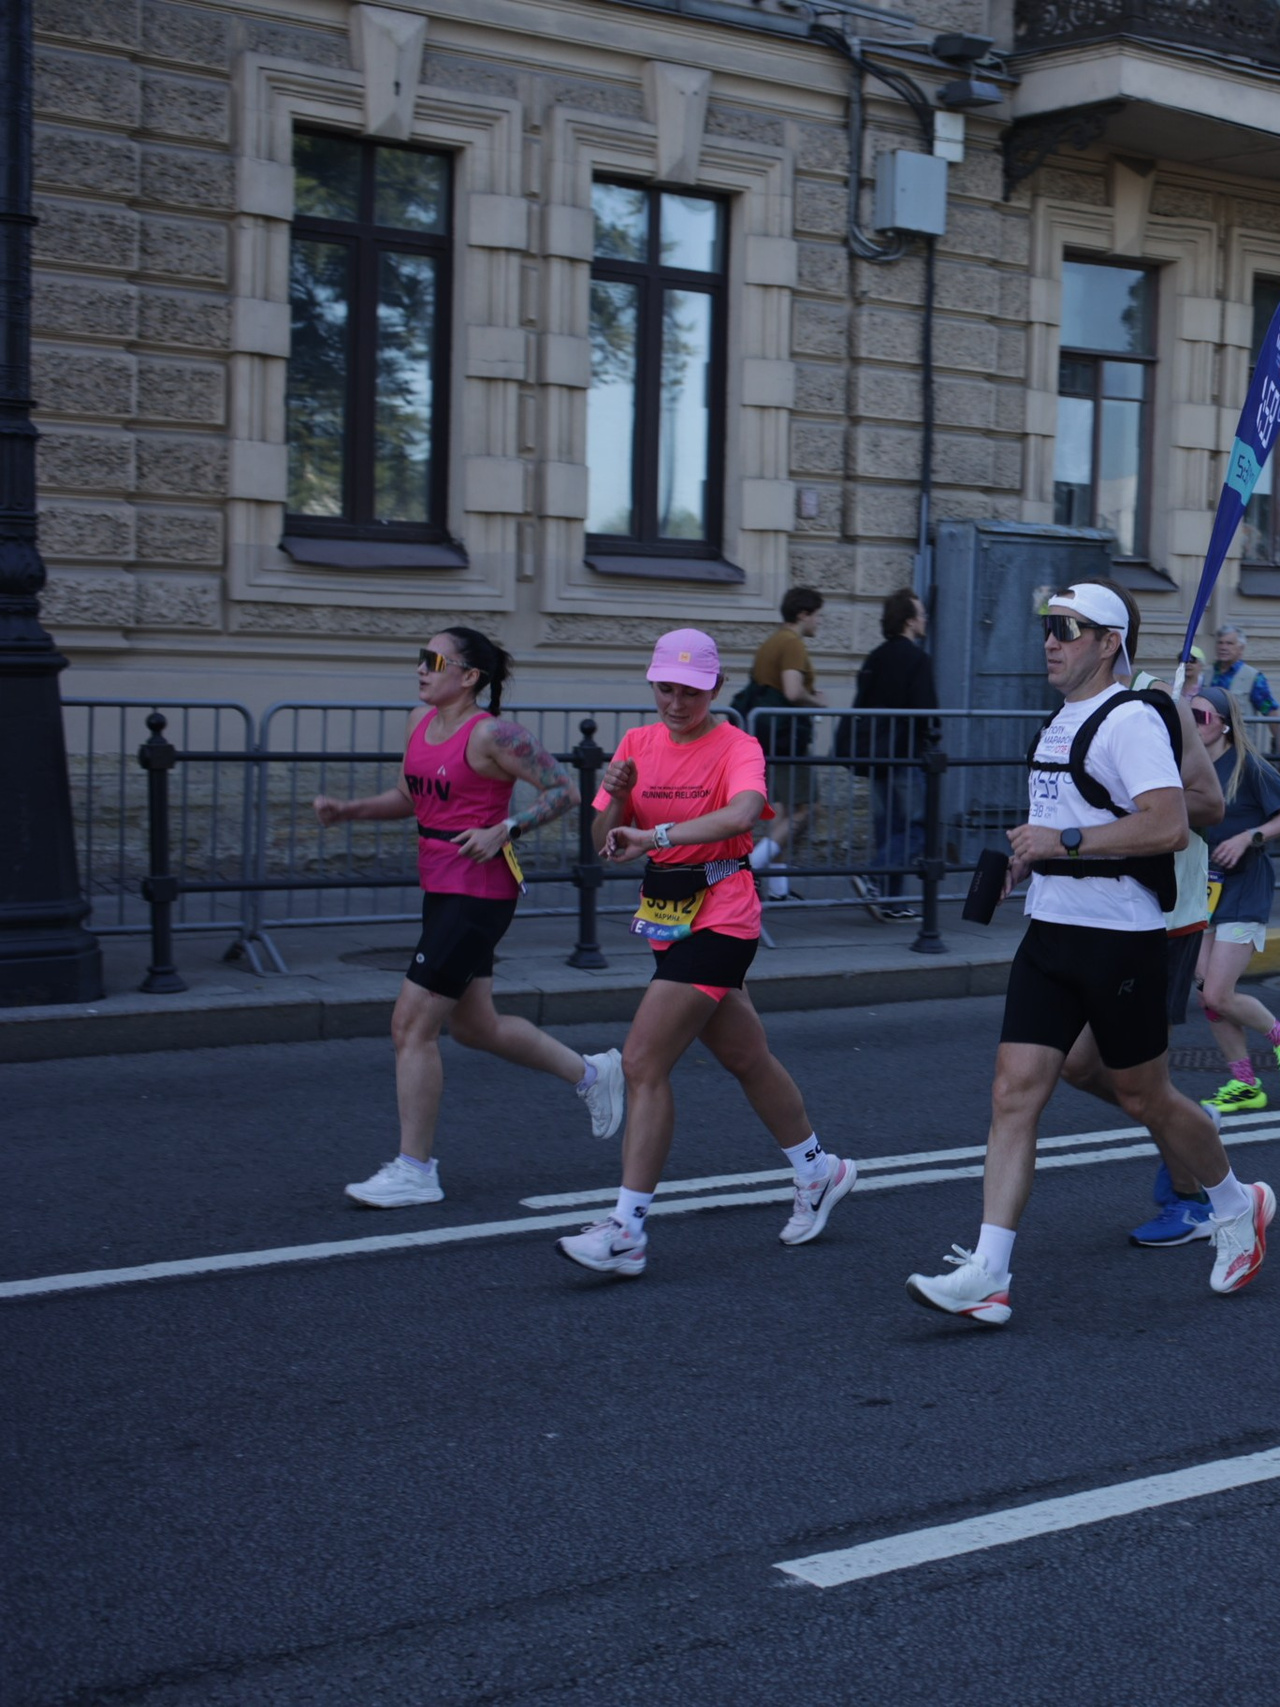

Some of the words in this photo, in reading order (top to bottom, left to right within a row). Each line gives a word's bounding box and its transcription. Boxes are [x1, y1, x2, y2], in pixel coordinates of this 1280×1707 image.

[641, 790, 673, 799] RUNNING
[675, 788, 712, 799] RELIGION
[634, 920, 646, 933] E
